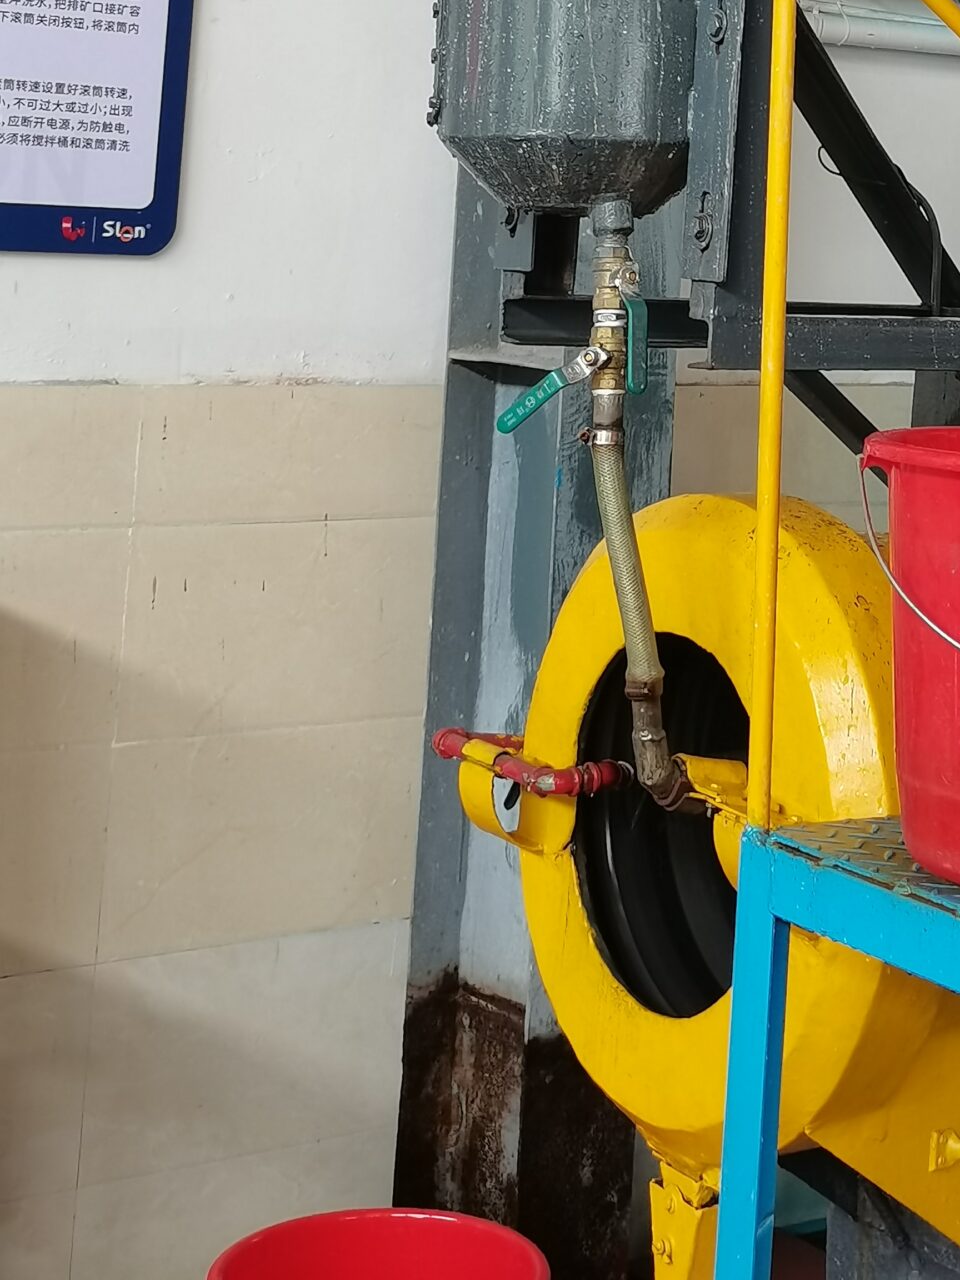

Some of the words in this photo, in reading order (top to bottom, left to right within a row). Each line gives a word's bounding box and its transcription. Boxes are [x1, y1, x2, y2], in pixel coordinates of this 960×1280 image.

[0, 78, 133, 101] 筒转速设置好滚筒转速，
